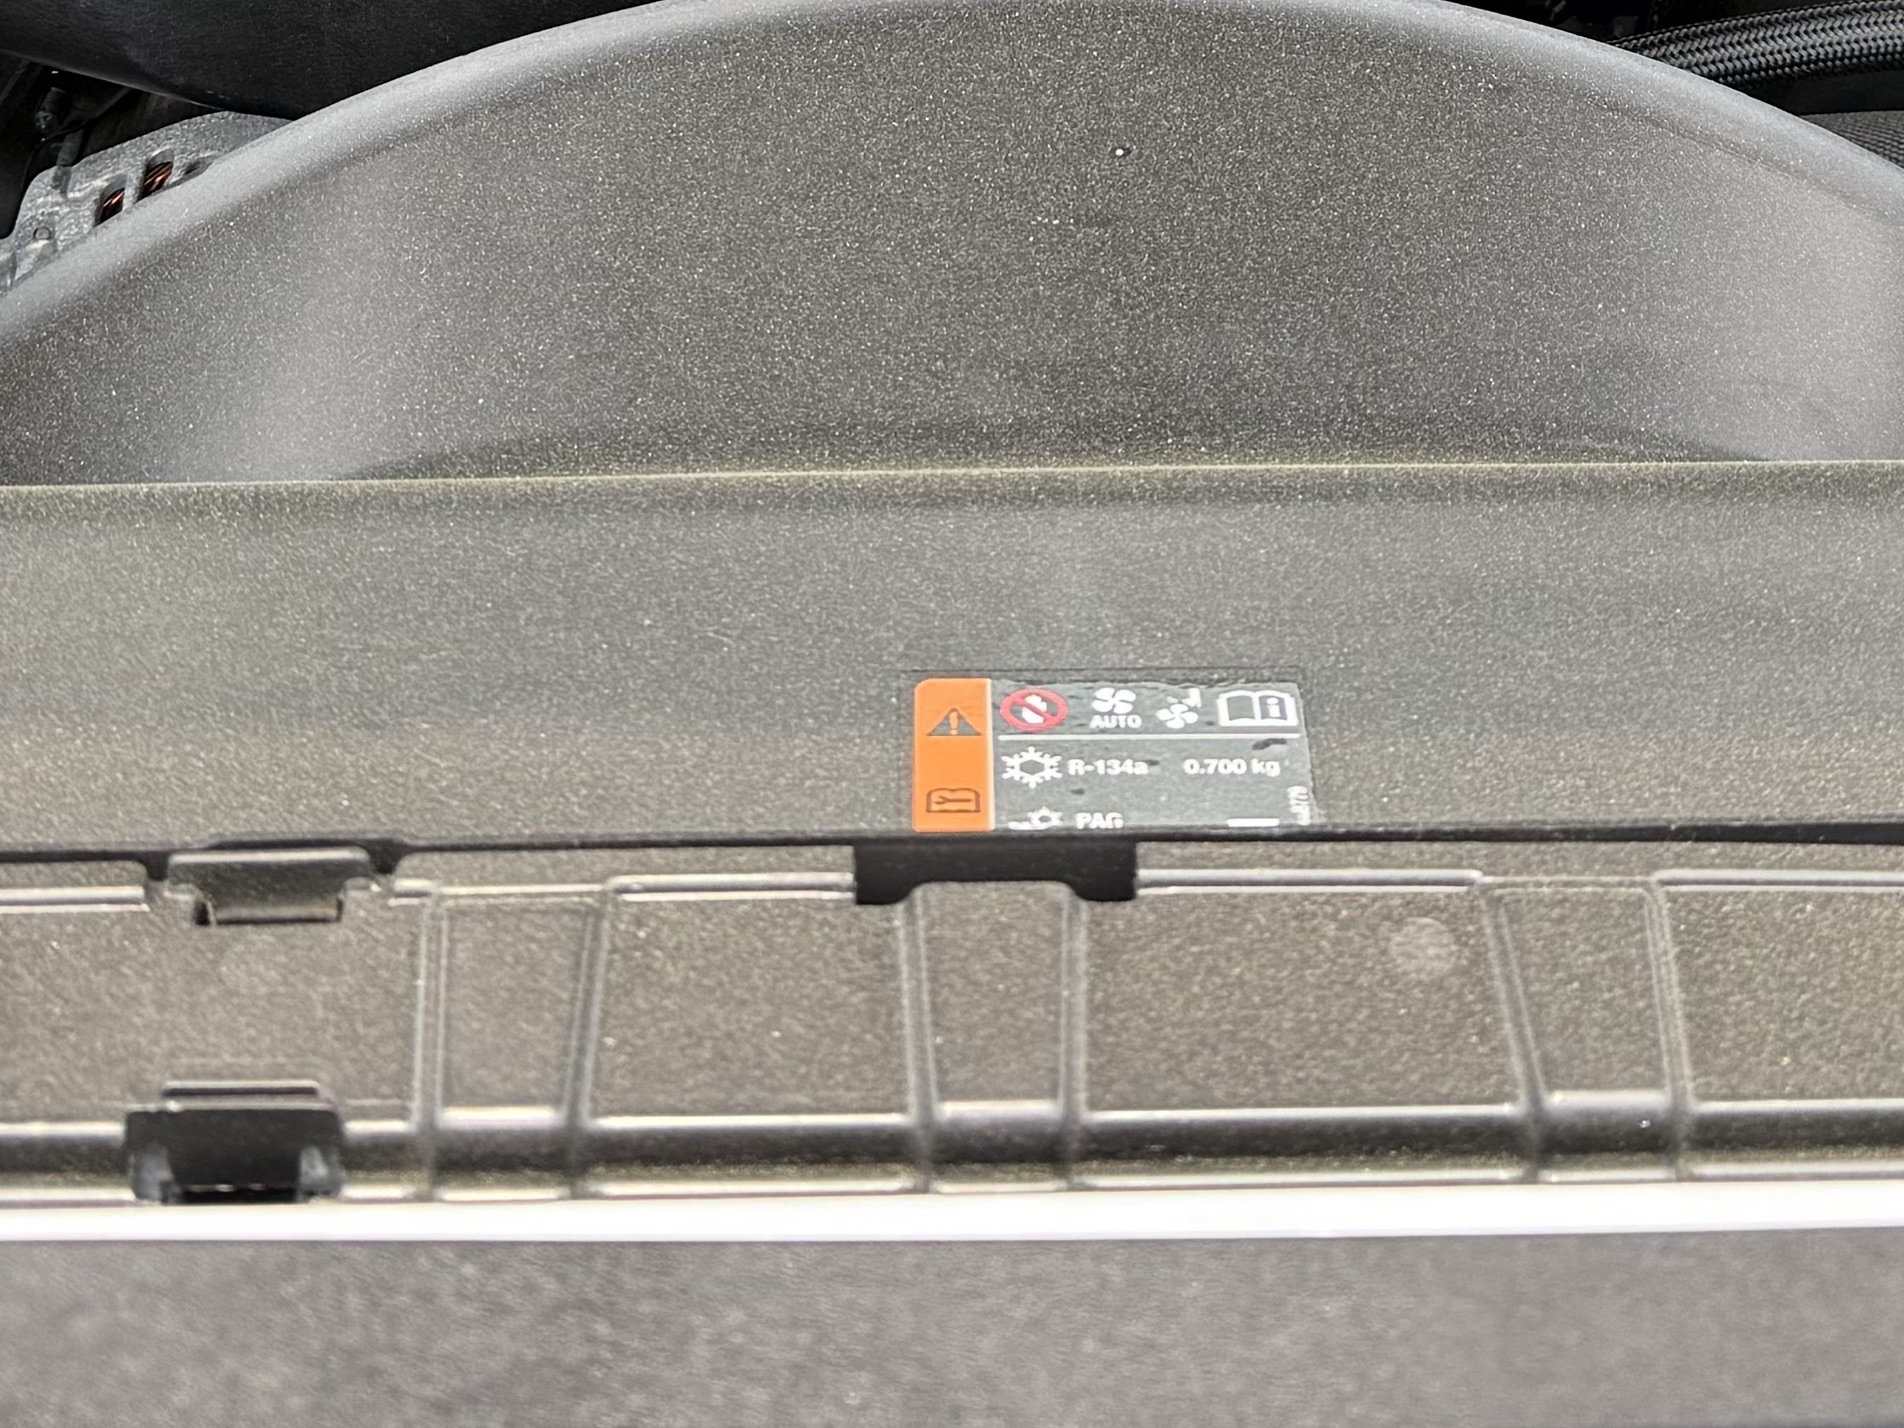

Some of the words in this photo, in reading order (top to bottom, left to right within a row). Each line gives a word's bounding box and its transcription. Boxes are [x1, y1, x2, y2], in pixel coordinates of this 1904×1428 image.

[1089, 714, 1143, 729] AUTO
[1068, 758, 1150, 776] R-134a
[1183, 758, 1246, 775] 0.700
[1251, 757, 1281, 778] kg
[1076, 812, 1124, 830] PAG
